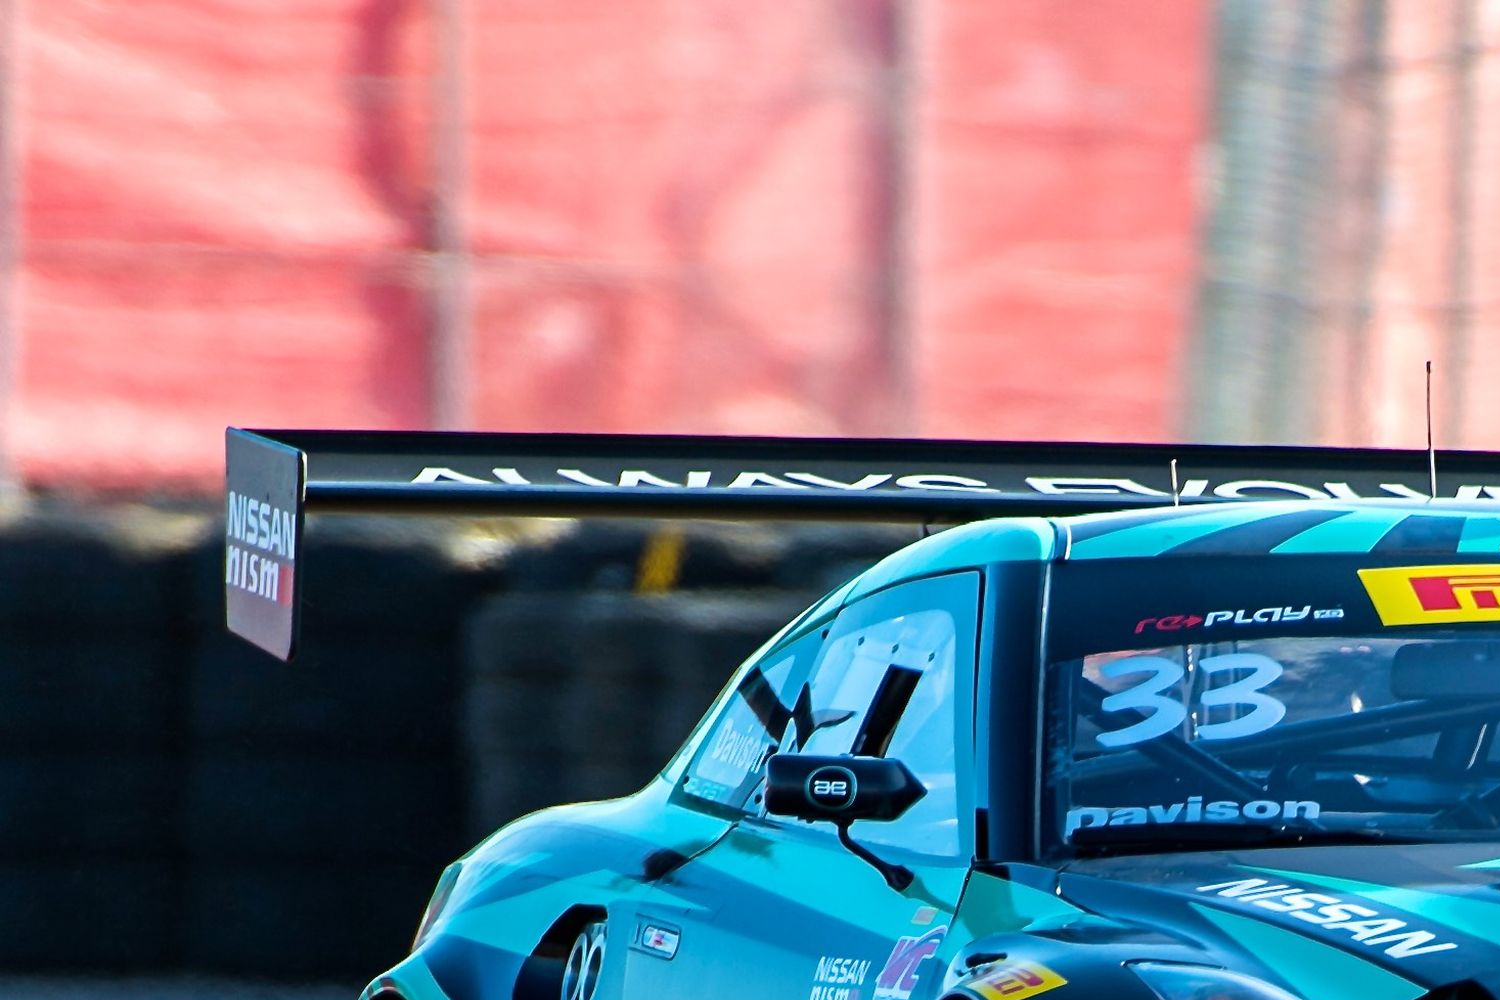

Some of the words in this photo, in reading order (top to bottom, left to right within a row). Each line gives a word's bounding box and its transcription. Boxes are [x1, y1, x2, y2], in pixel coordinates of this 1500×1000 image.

[227, 491, 296, 560] NISSAN
[1096, 653, 1287, 748] 33
[1196, 878, 1459, 959] NISSAN
[814, 956, 871, 986] NISSAN
